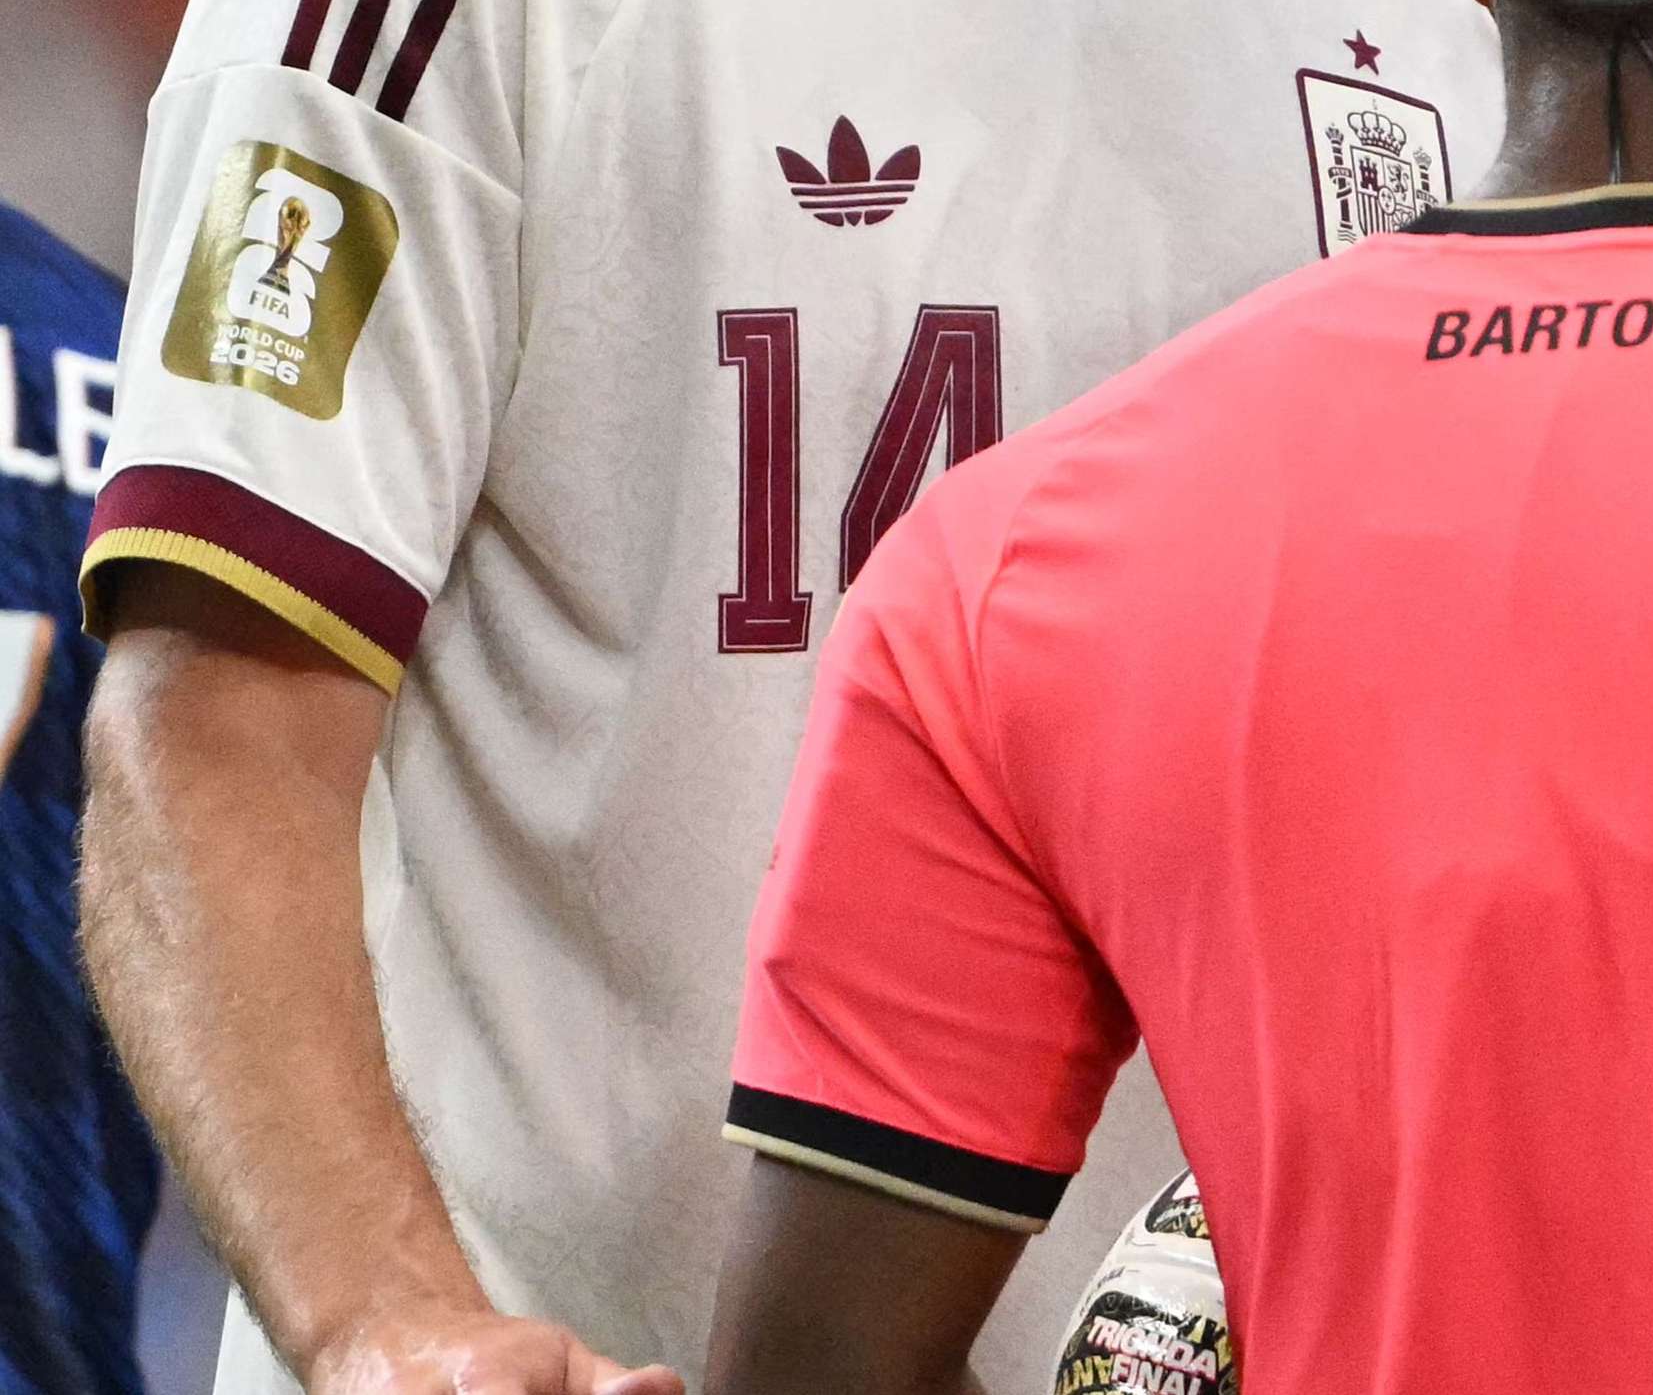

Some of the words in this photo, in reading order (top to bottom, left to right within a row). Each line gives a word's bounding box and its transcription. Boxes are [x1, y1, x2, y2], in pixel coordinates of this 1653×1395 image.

[249, 289, 289, 319] FIFA
[210, 341, 300, 385] 2026
[274, 339, 305, 362] CUP
[716, 304, 1003, 654] 14
